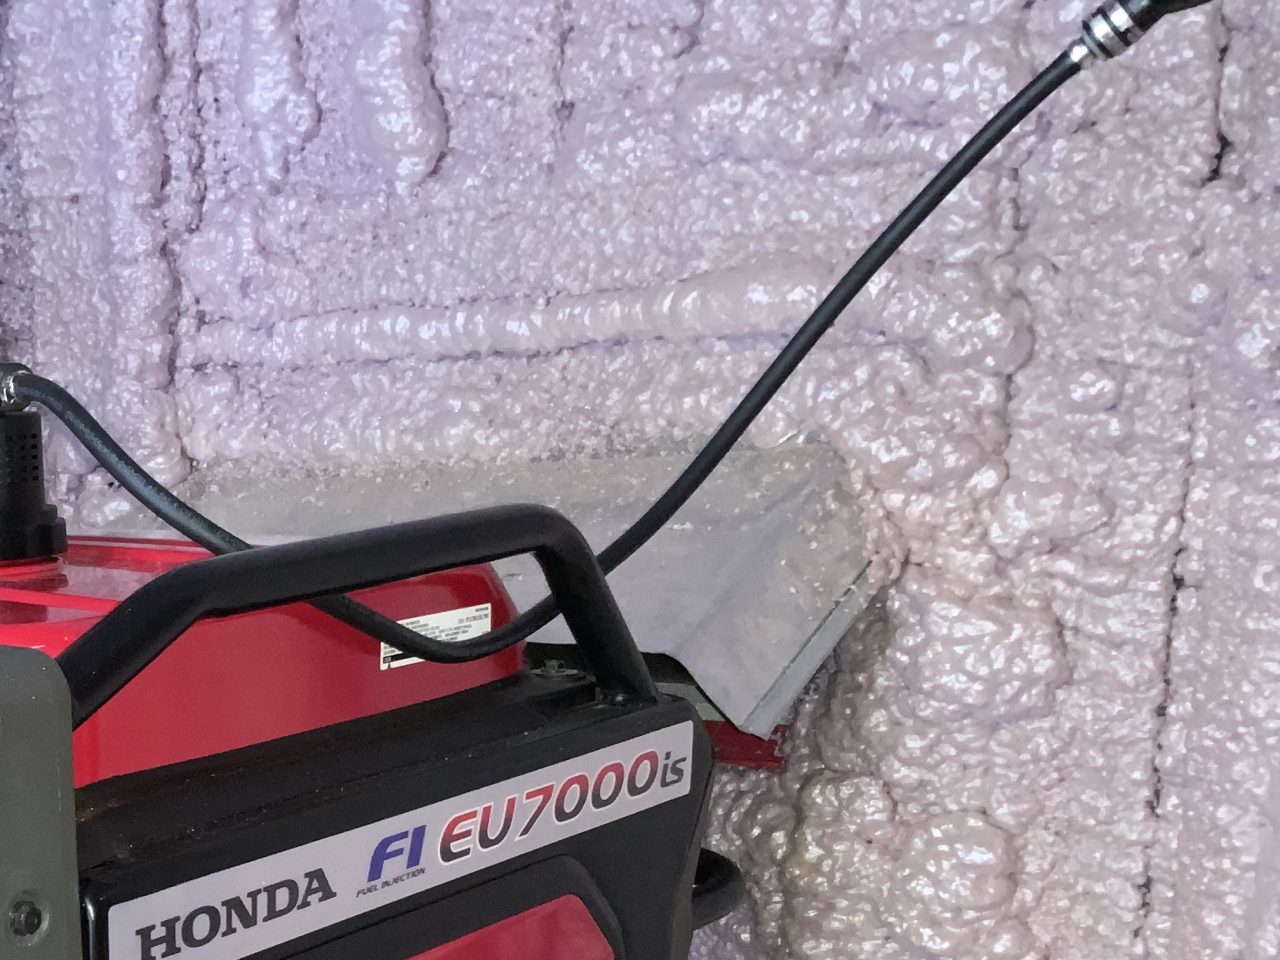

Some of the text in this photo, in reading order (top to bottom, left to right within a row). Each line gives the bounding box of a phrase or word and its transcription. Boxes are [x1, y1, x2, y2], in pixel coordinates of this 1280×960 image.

[367, 824, 427, 883] FI
[355, 867, 426, 898] FUEL INJECTION
